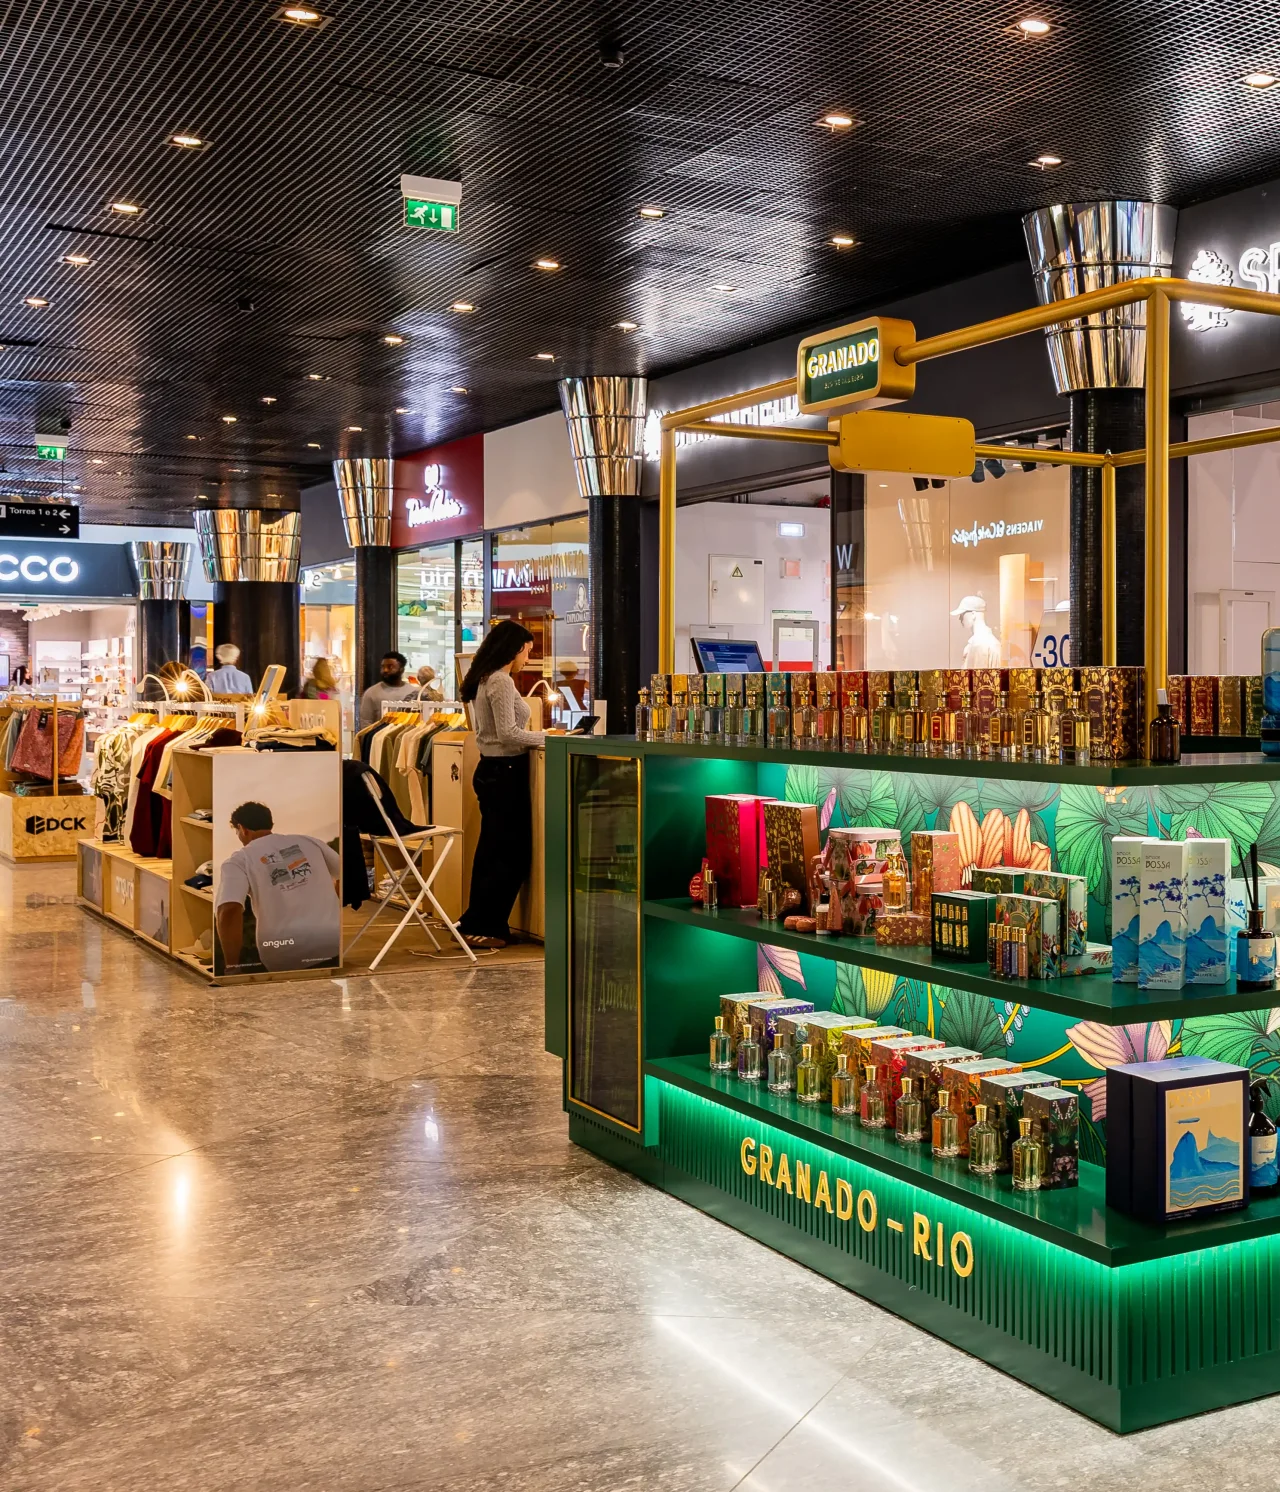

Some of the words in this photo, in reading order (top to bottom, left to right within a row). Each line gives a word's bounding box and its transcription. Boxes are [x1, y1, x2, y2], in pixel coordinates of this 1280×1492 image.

[807, 338, 879, 379] GRANADO
[9, 507, 36, 515] Torres
[1145, 861, 1171, 869] BOSSA
[740, 1137, 877, 1233] GRANADO
[913, 1210, 974, 1278] RIO
